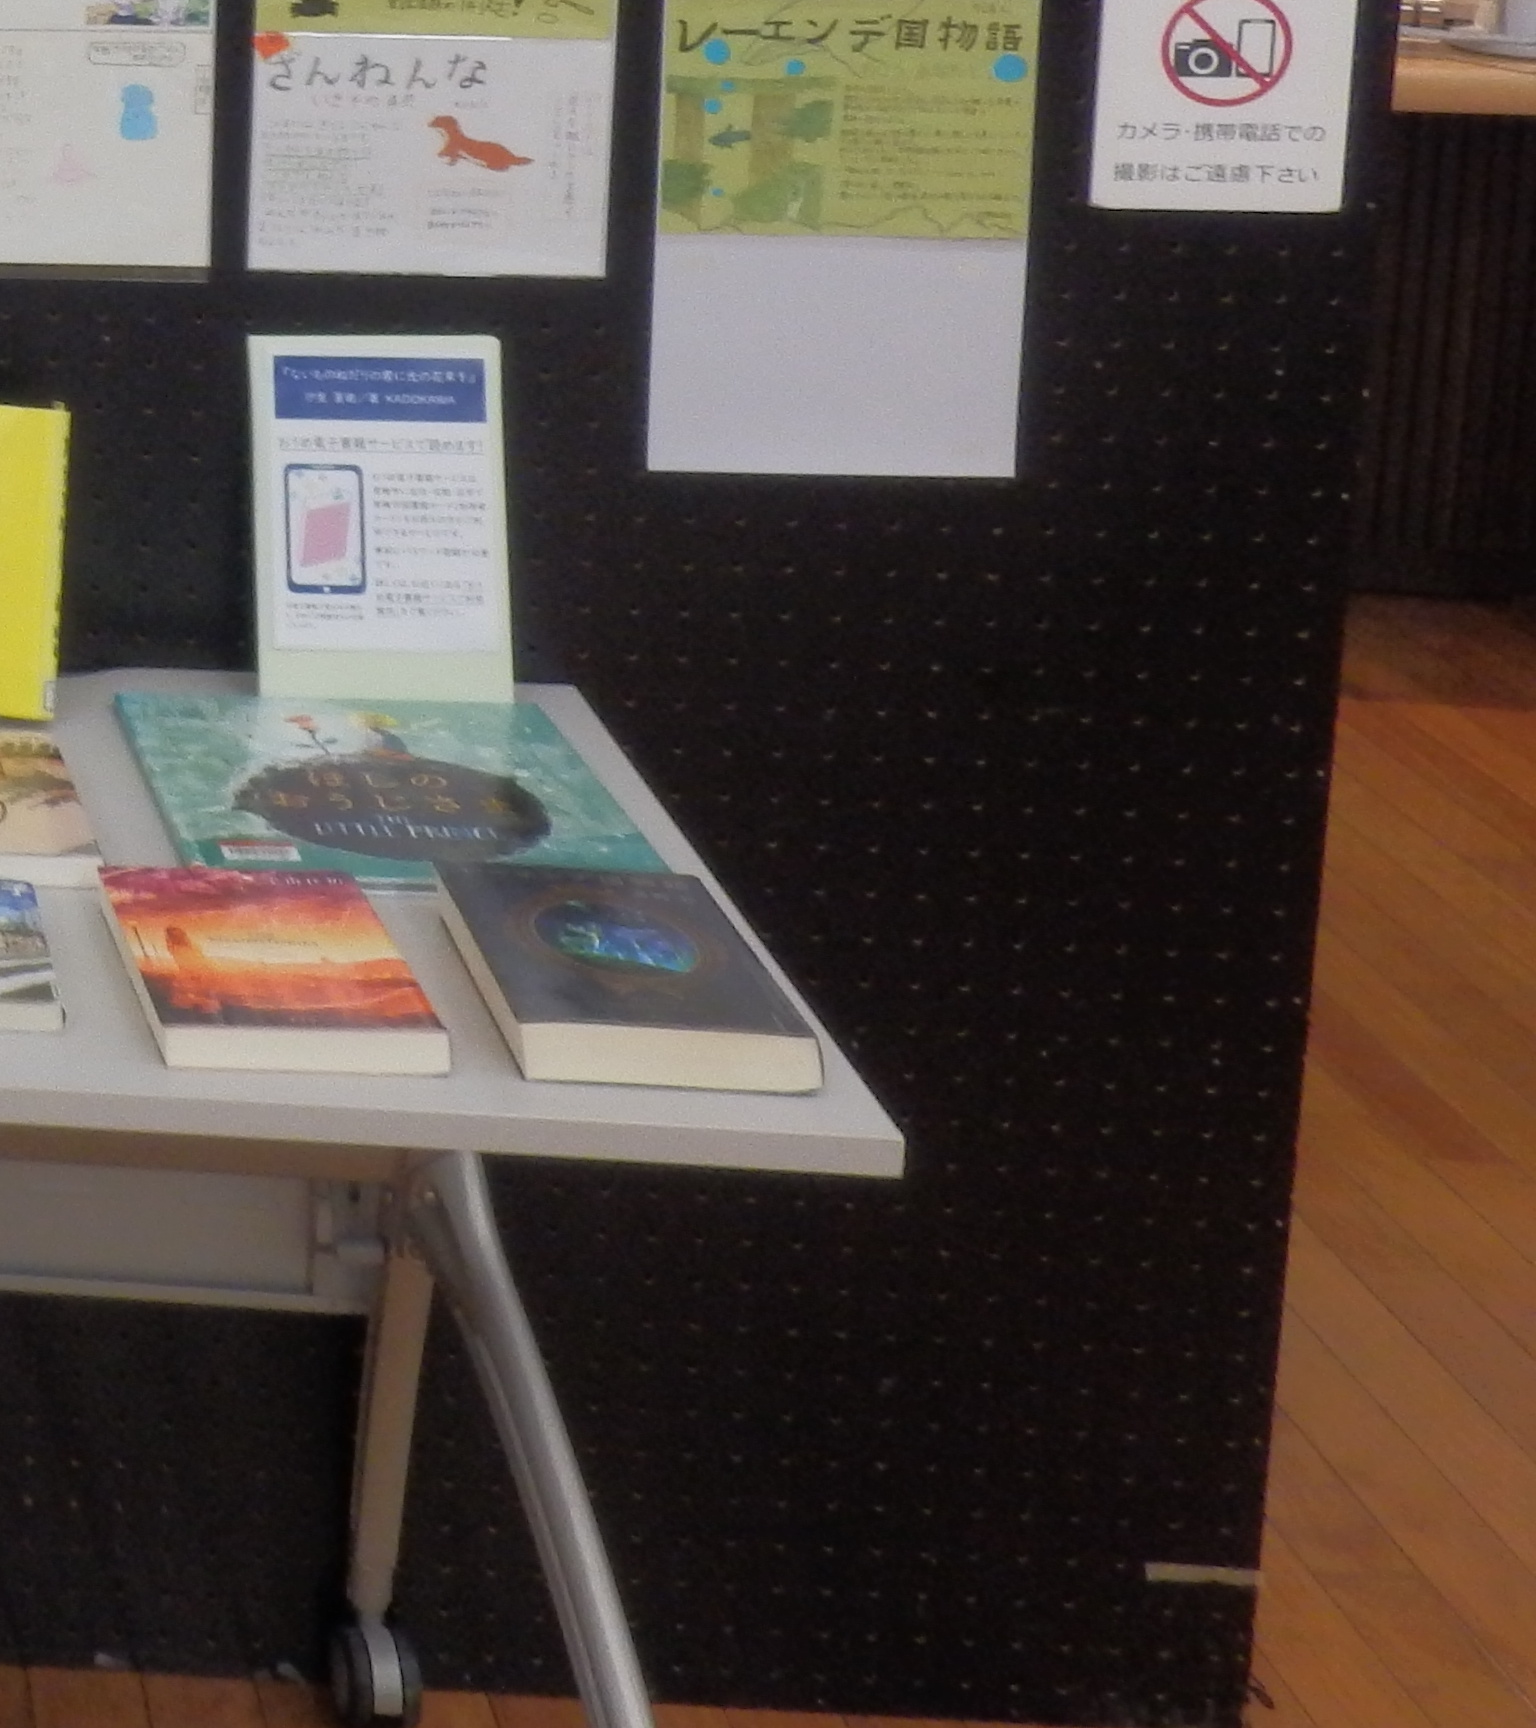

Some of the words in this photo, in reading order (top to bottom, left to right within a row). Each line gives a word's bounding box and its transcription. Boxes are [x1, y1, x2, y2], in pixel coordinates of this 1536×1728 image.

[677, 14, 1024, 54] レーエンデ国物語
[268, 51, 490, 92] ざんねんな
[1113, 162, 1318, 184] 撮影はご遠慮下さい
